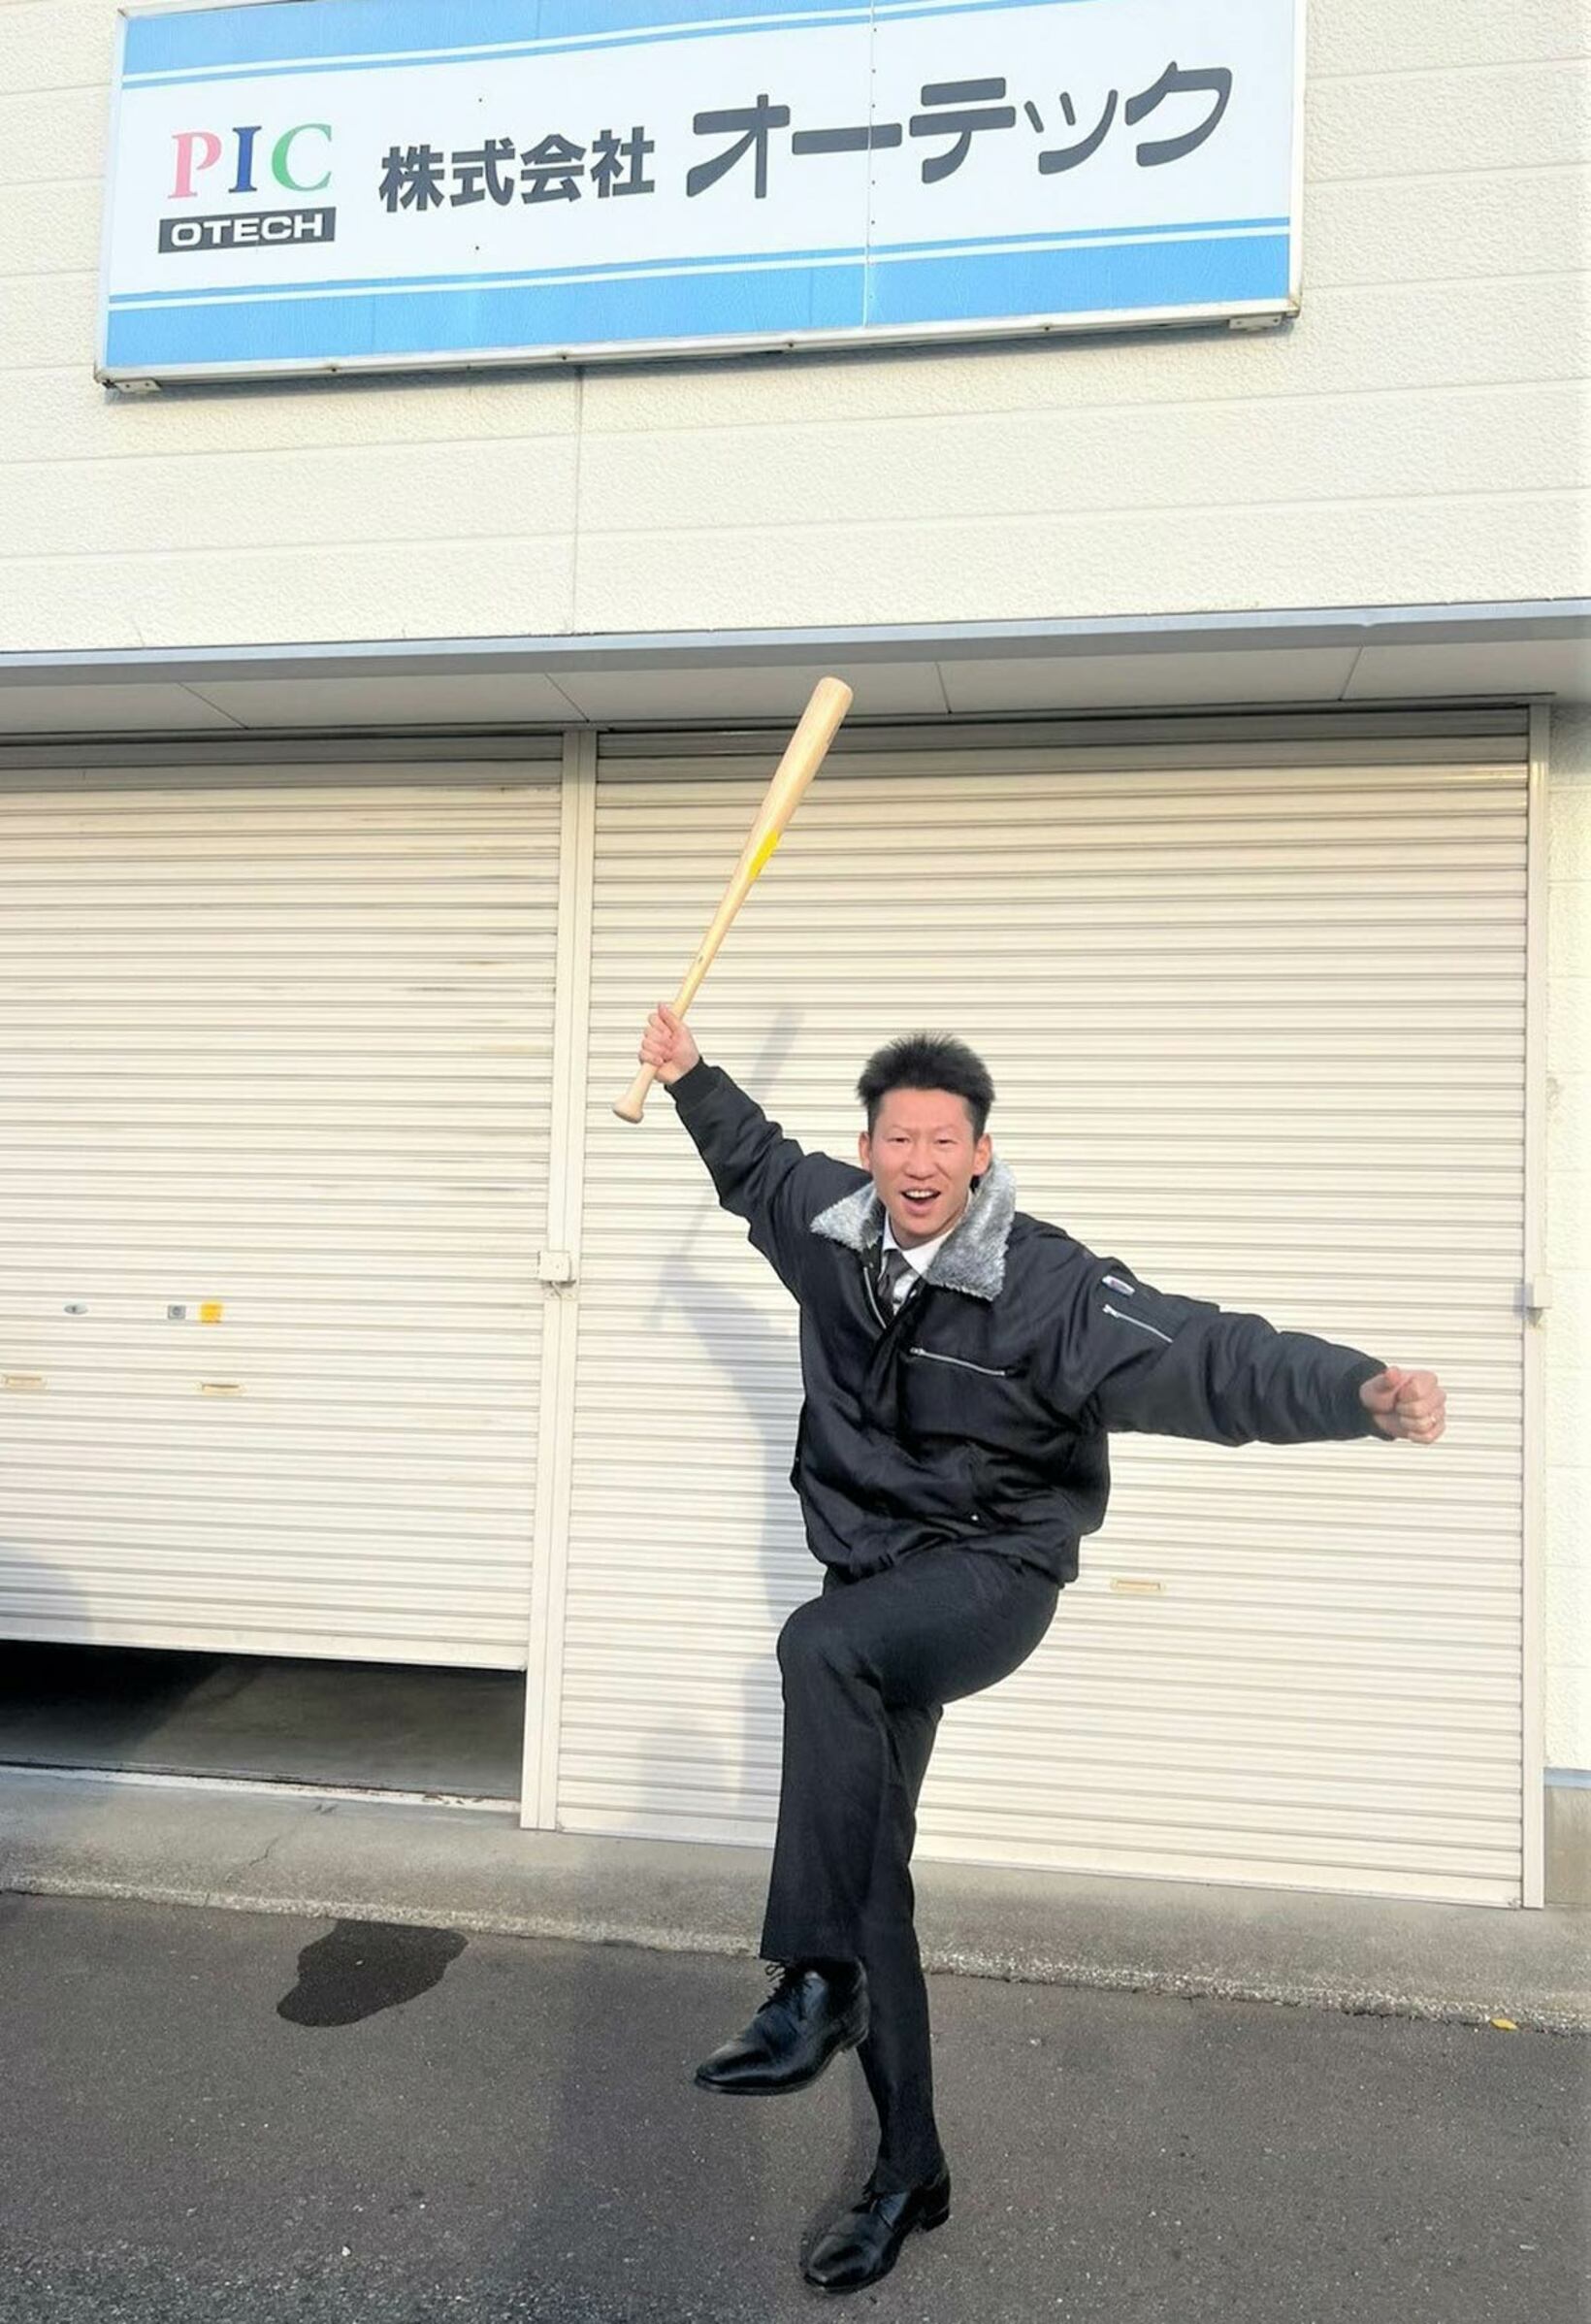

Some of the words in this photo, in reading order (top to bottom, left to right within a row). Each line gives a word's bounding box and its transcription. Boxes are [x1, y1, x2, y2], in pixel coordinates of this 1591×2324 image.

[168, 123, 333, 199] PIC
[378, 126, 656, 213] 株式会社
[685, 60, 1233, 199] オーテック
[170, 213, 325, 248] OTECH
